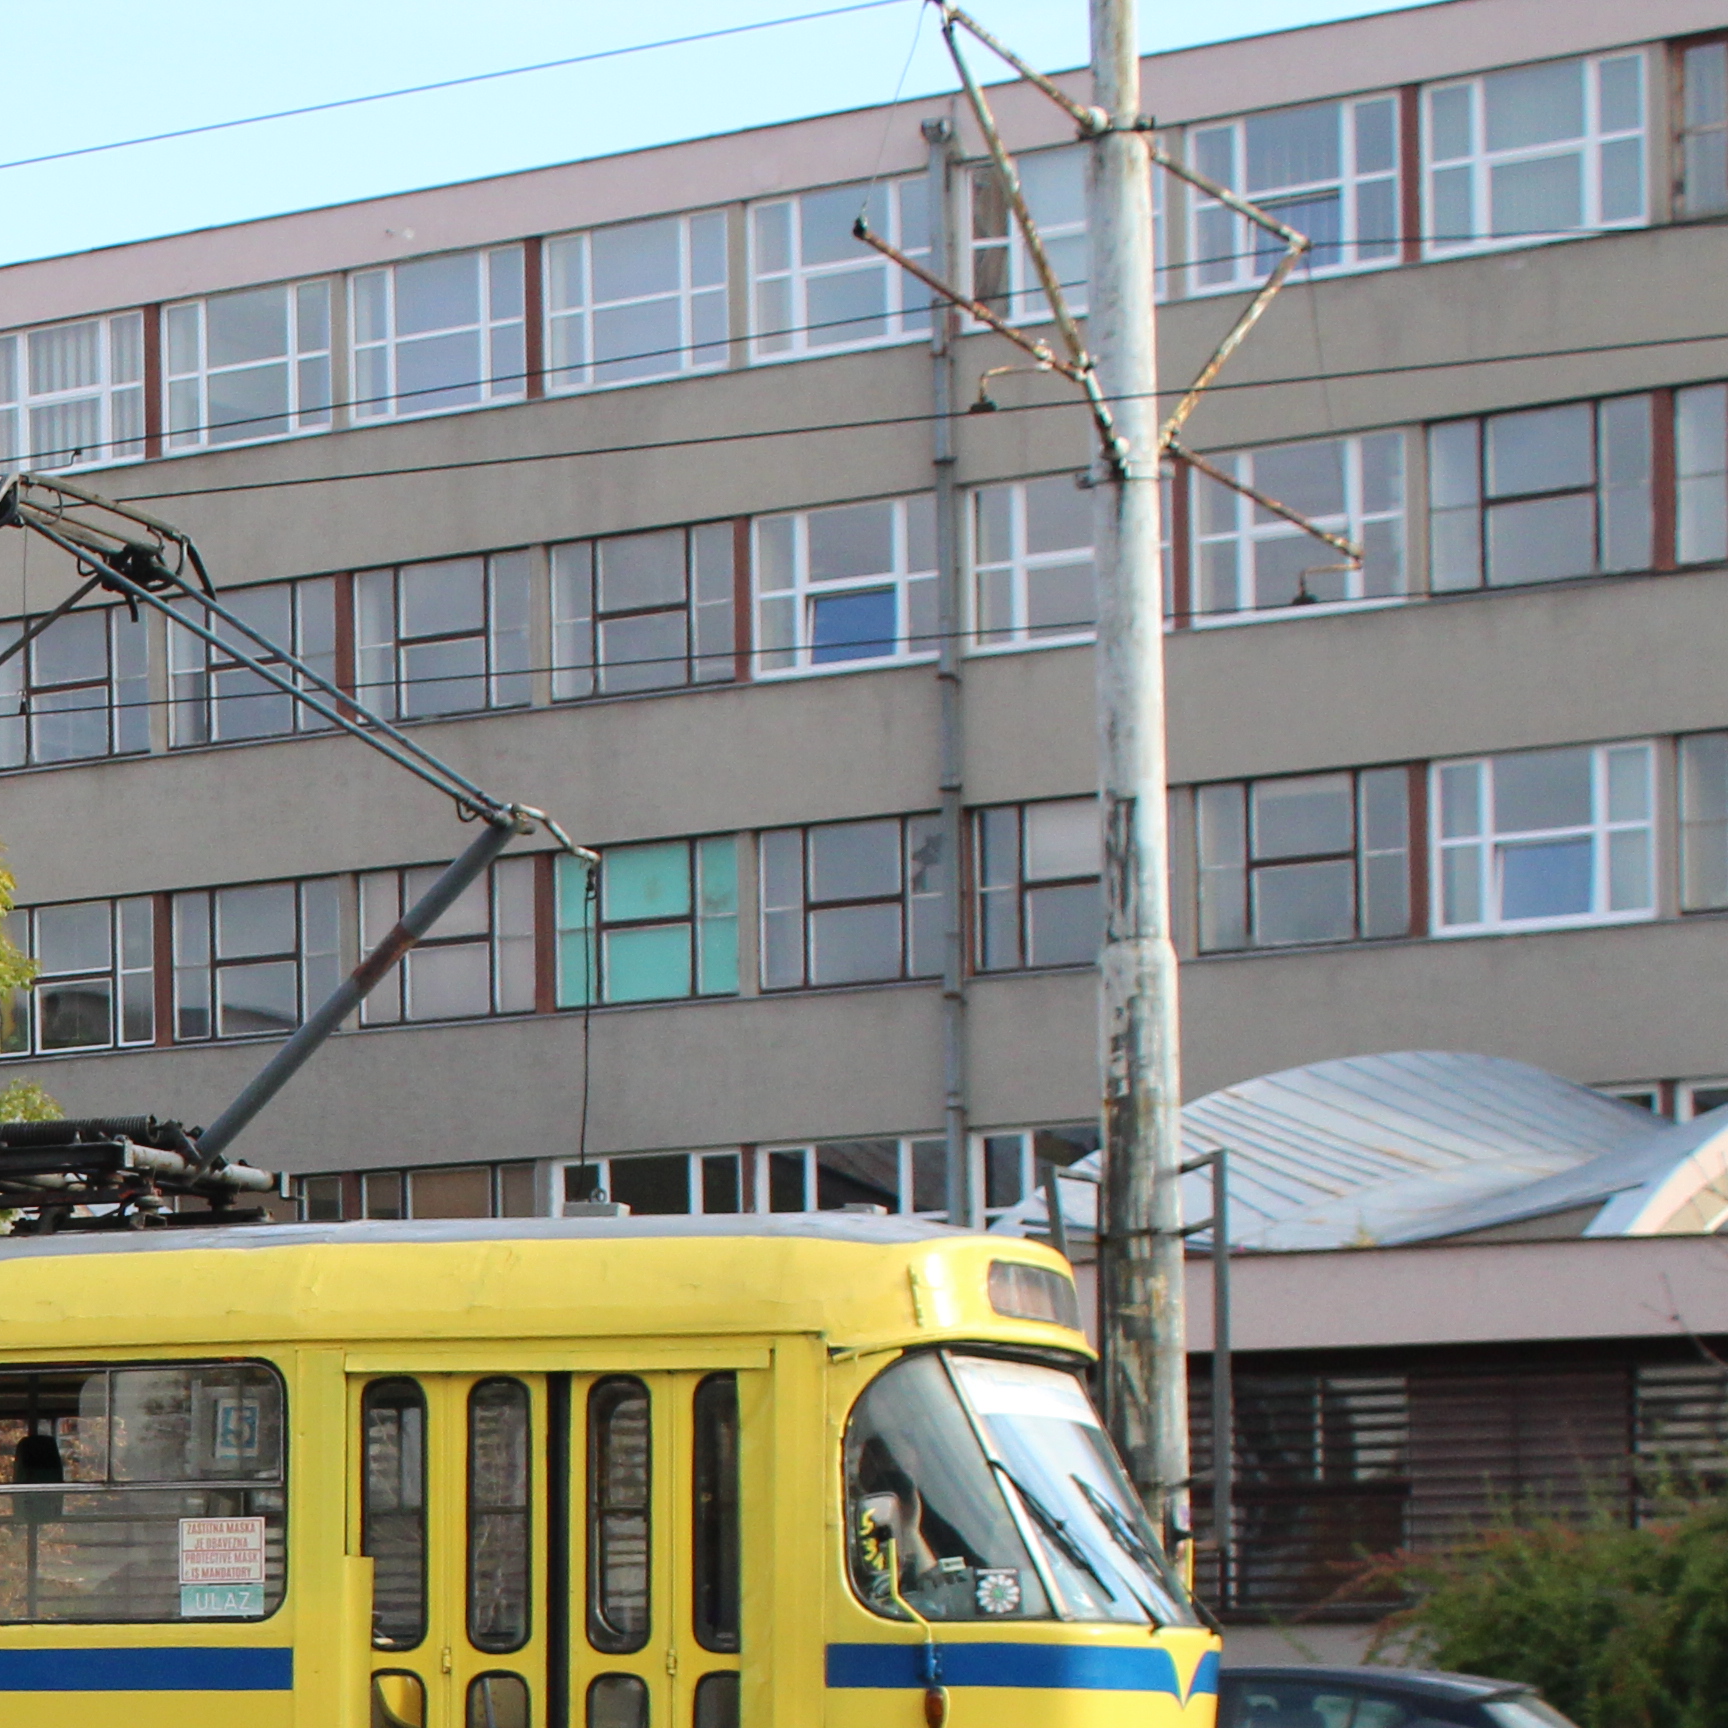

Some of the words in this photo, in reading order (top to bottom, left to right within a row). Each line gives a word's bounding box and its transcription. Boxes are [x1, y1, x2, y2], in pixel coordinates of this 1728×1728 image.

[226, 1522, 255, 1533] MASKA
[234, 1551, 258, 1562] MASK
[201, 1567, 252, 1578] MANDATORY
[196, 1591, 251, 1611] ULAZ
